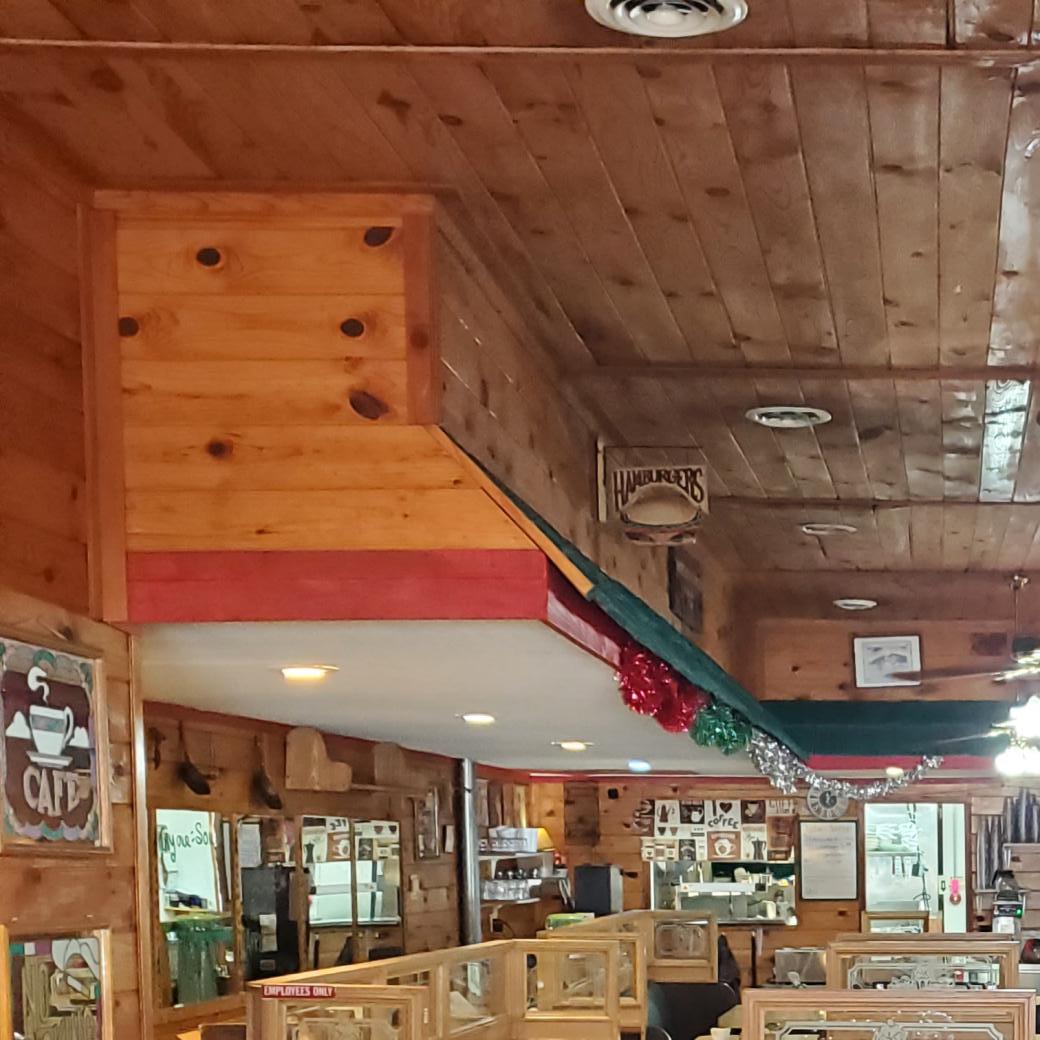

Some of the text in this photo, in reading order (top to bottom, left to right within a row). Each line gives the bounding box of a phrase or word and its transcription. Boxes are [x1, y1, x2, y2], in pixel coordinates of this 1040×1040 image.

[613, 467, 704, 513] HAMBURGERS
[23, 765, 81, 817] CAFE
[708, 814, 739, 830] COFFEE
[264, 985, 333, 997] EMPLOYEES ONLY
